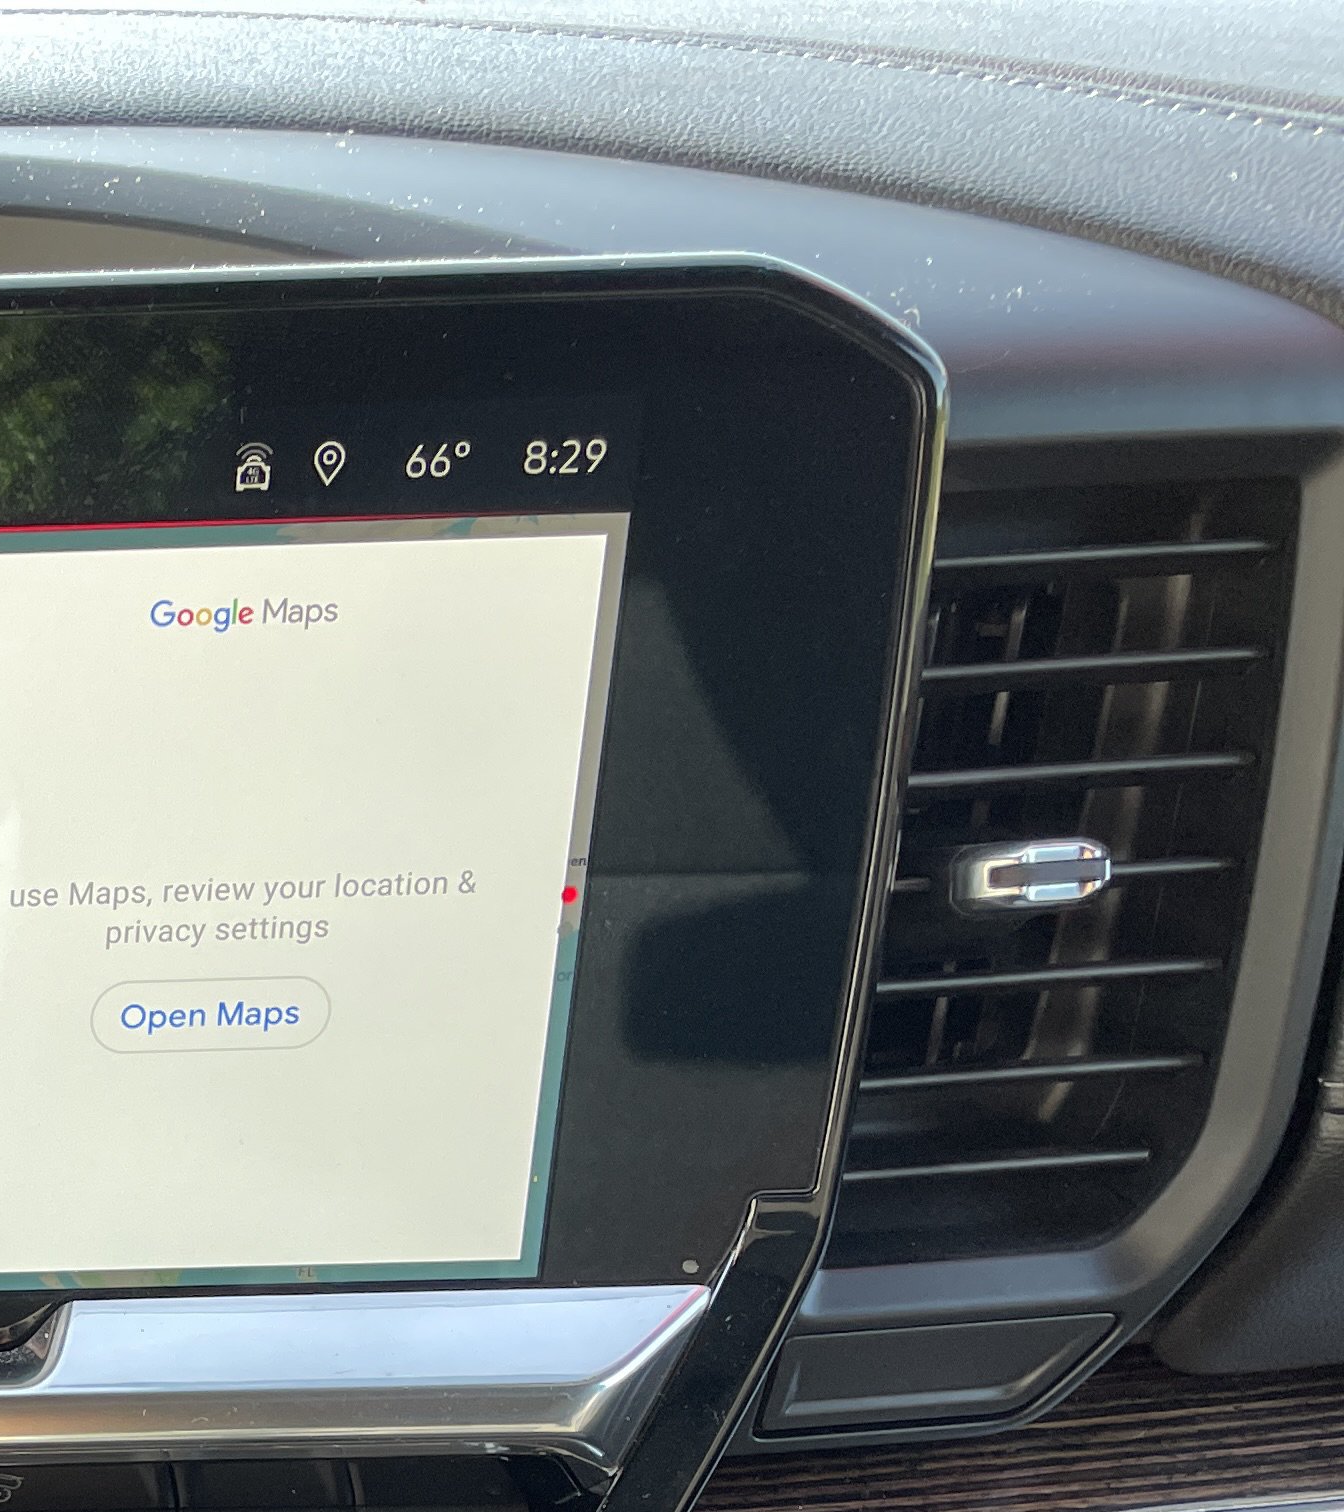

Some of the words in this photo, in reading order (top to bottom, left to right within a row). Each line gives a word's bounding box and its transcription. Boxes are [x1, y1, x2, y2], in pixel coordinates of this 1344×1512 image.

[523, 439, 607, 475] 8:29
[150, 598, 254, 633] Google
[262, 598, 339, 630] Maps
[9, 888, 59, 908] use
[68, 880, 153, 911] Maps,
[161, 879, 256, 904] review
[263, 880, 326, 906] your
[333, 872, 449, 900] location
[457, 870, 478, 895] &
[104, 923, 207, 950] privacy
[214, 917, 330, 945] settings
[120, 1003, 207, 1035] Open
[216, 1001, 301, 1033] Maps
